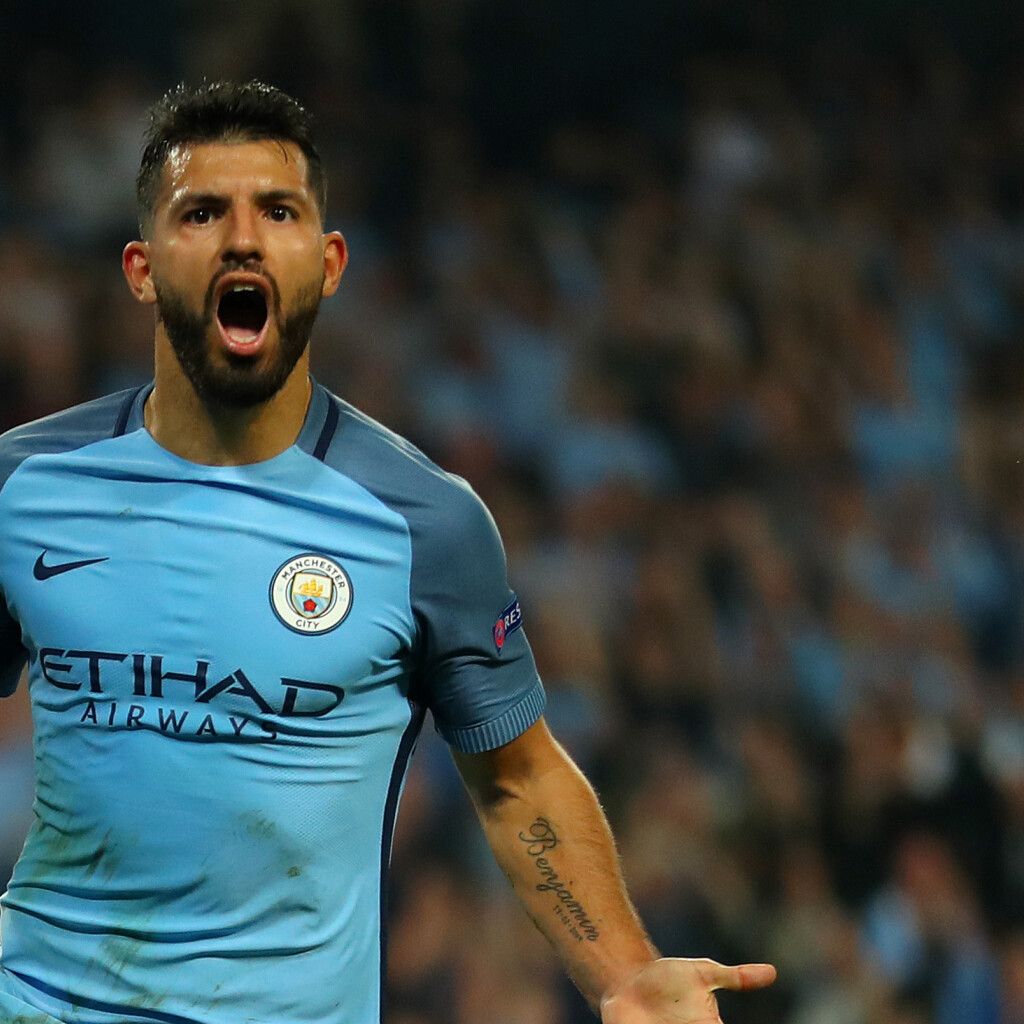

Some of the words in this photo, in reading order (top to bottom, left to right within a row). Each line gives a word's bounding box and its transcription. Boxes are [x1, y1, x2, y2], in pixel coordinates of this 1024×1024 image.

[281, 559, 346, 589] MANCHESTER
[295, 619, 320, 630] CITY
[39, 647, 345, 718] ETIHAD
[80, 701, 278, 740] AIRWAYS
[518, 815, 600, 941] Benjamin
